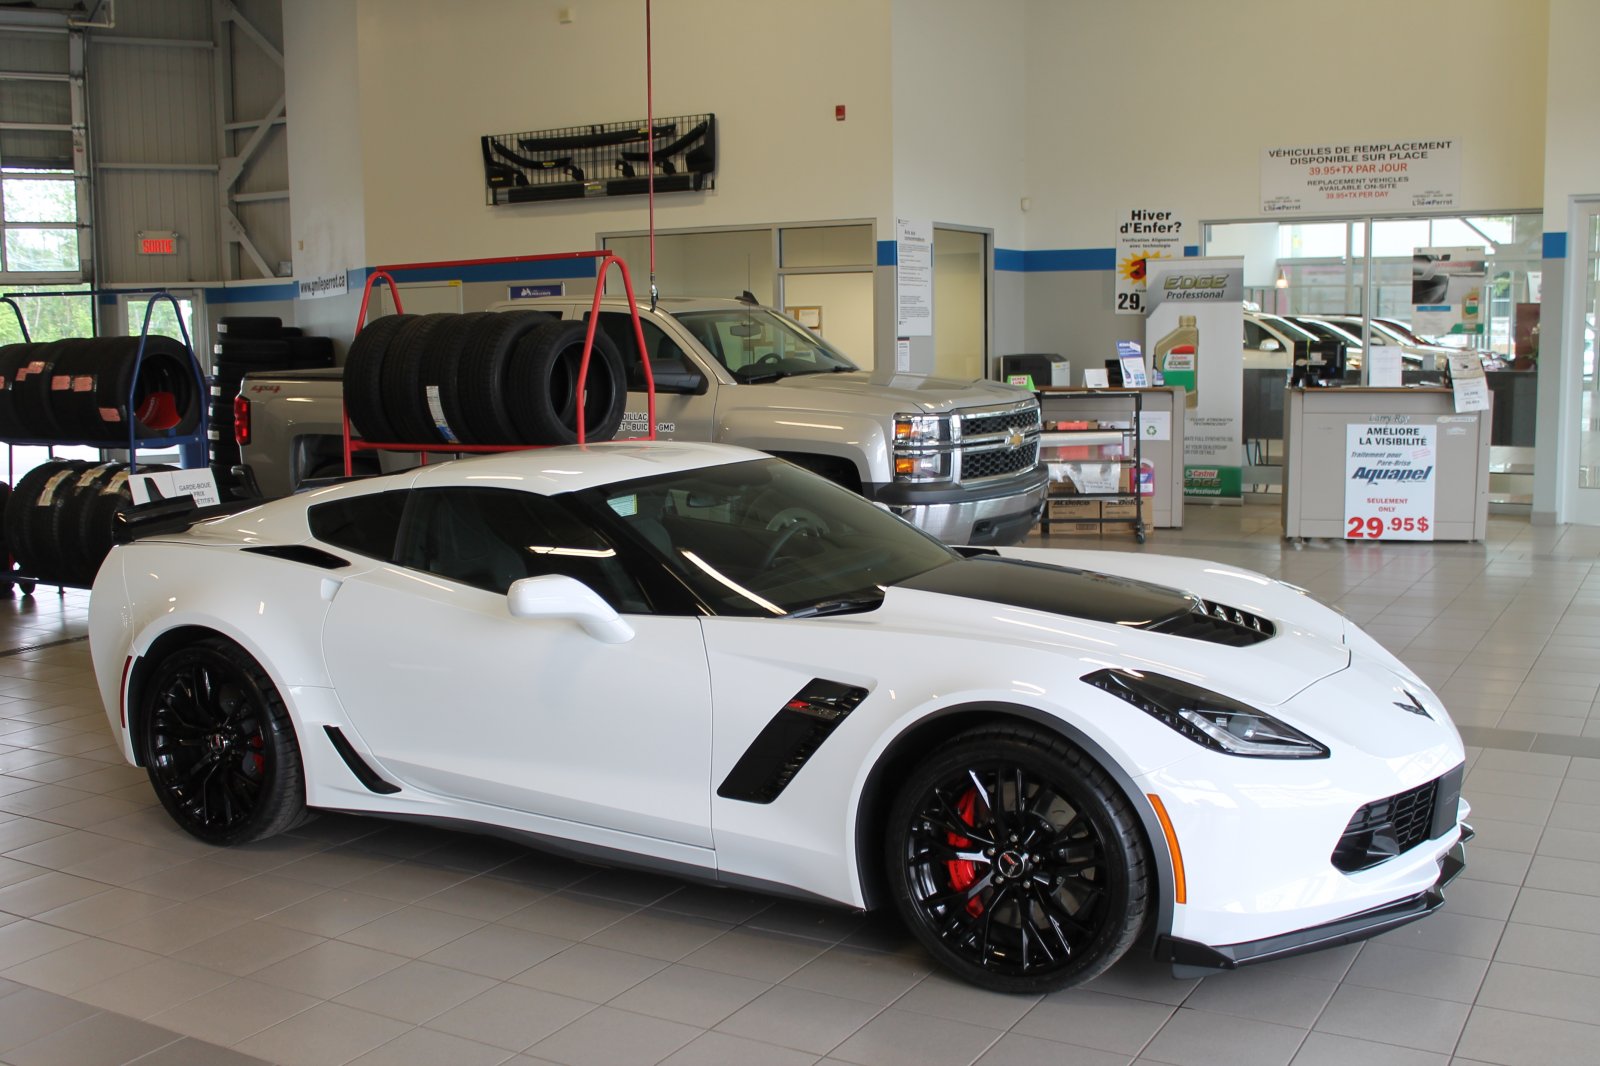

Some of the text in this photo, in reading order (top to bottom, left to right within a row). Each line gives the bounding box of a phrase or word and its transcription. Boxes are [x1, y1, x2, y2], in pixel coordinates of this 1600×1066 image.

[1268, 140, 1453, 158] VÉHICULES DE REMPLACEMENT
[1290, 151, 1428, 166] DISPONIBLE SUR PLACE
[1309, 162, 1408, 176] 39.95+TX PAR JOUR
[1307, 176, 1409, 186] REPLACEMENT VEHICLES
[1319, 182, 1397, 192] AVAILABLE ON-SITE
[1131, 210, 1172, 221] Hiver
[1120, 222, 1182, 234] d'Enfer?
[142, 239, 173, 254] SORTIE
[1164, 274, 1230, 290] EDGE
[1166, 290, 1224, 300] Professional
[658, 424, 674, 432] GMC
[1366, 425, 1420, 436] AMÉLIORE
[1359, 436, 1428, 446] LA VISIBILITÉ
[1352, 466, 1433, 485] Aquapel
